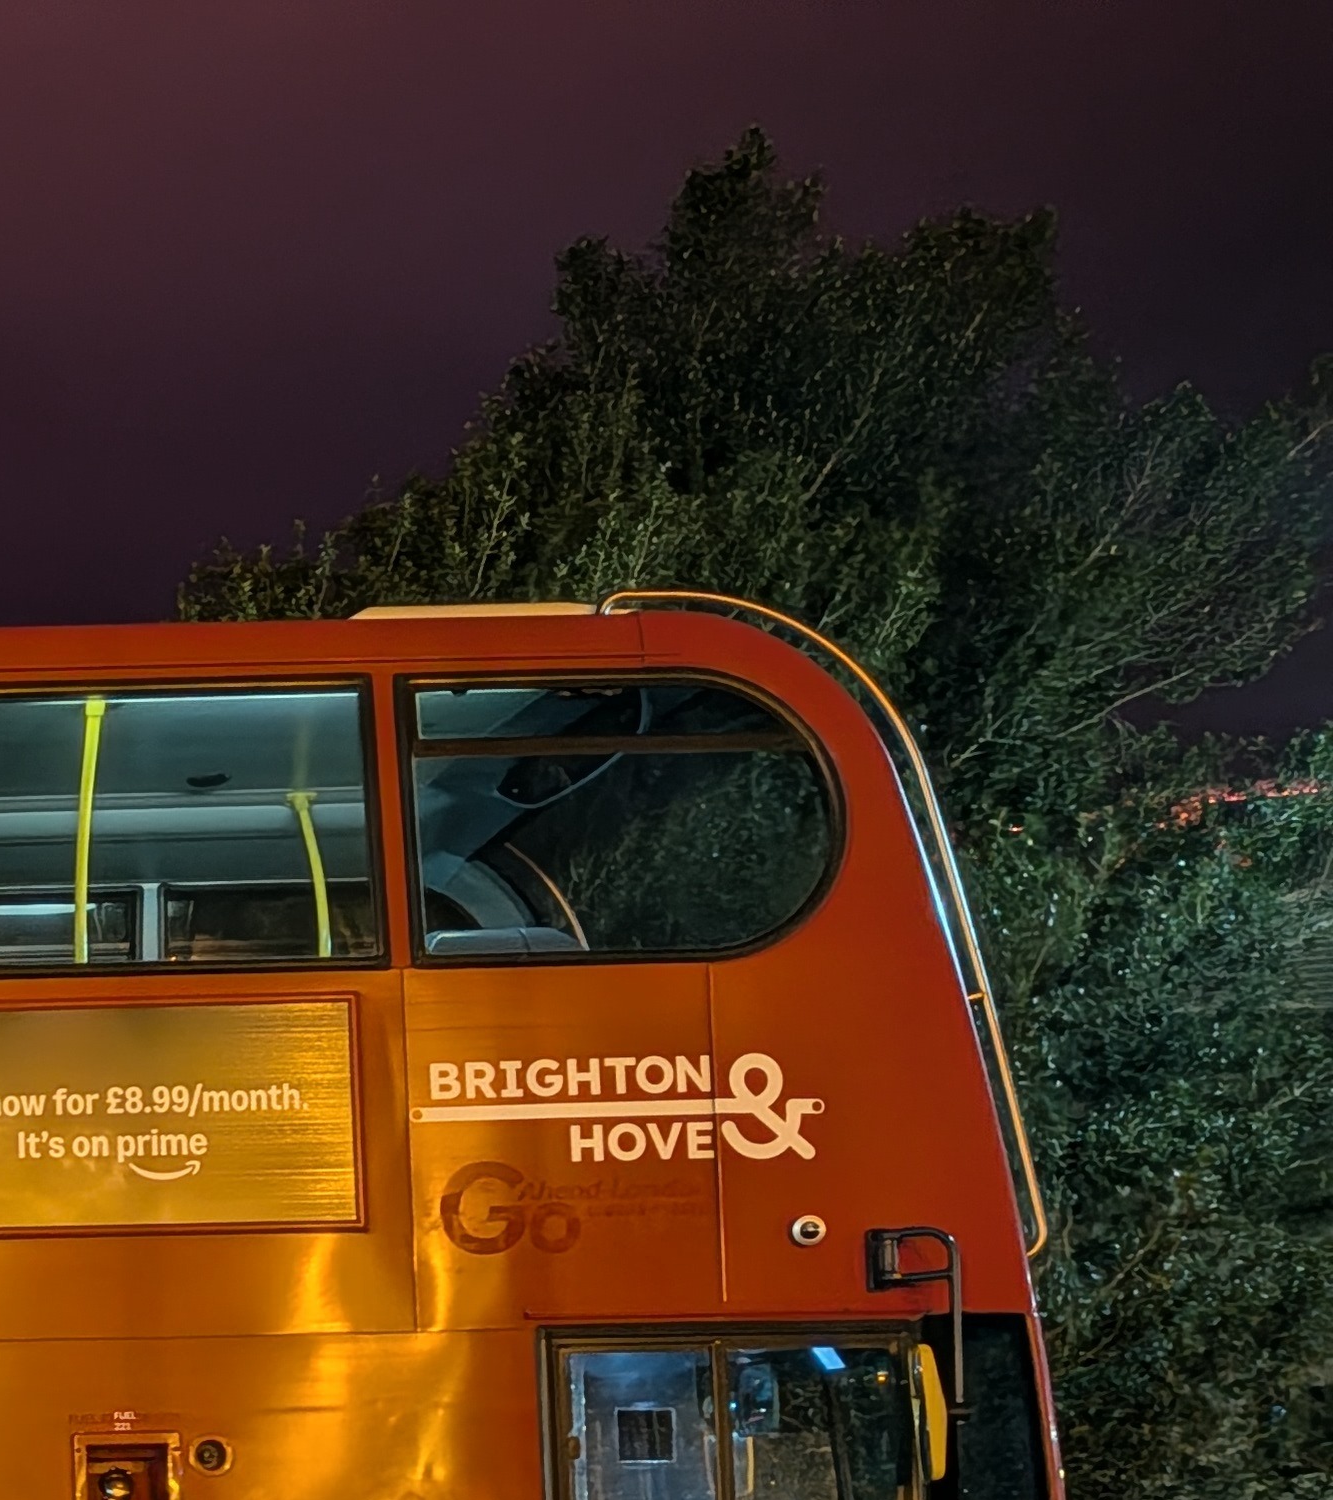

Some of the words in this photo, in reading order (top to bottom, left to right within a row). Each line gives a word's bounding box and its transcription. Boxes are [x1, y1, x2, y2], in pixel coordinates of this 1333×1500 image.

[428, 1055, 712, 1100] BRIGHTON
[52, 1087, 100, 1116] for
[105, 1083, 309, 1117] £8.99/month.
[17, 1131, 65, 1160] It's
[71, 1136, 110, 1158] on
[117, 1127, 209, 1164] prime
[569, 1120, 715, 1163] HOVE
[114, 1411, 137, 1421] FUEL
